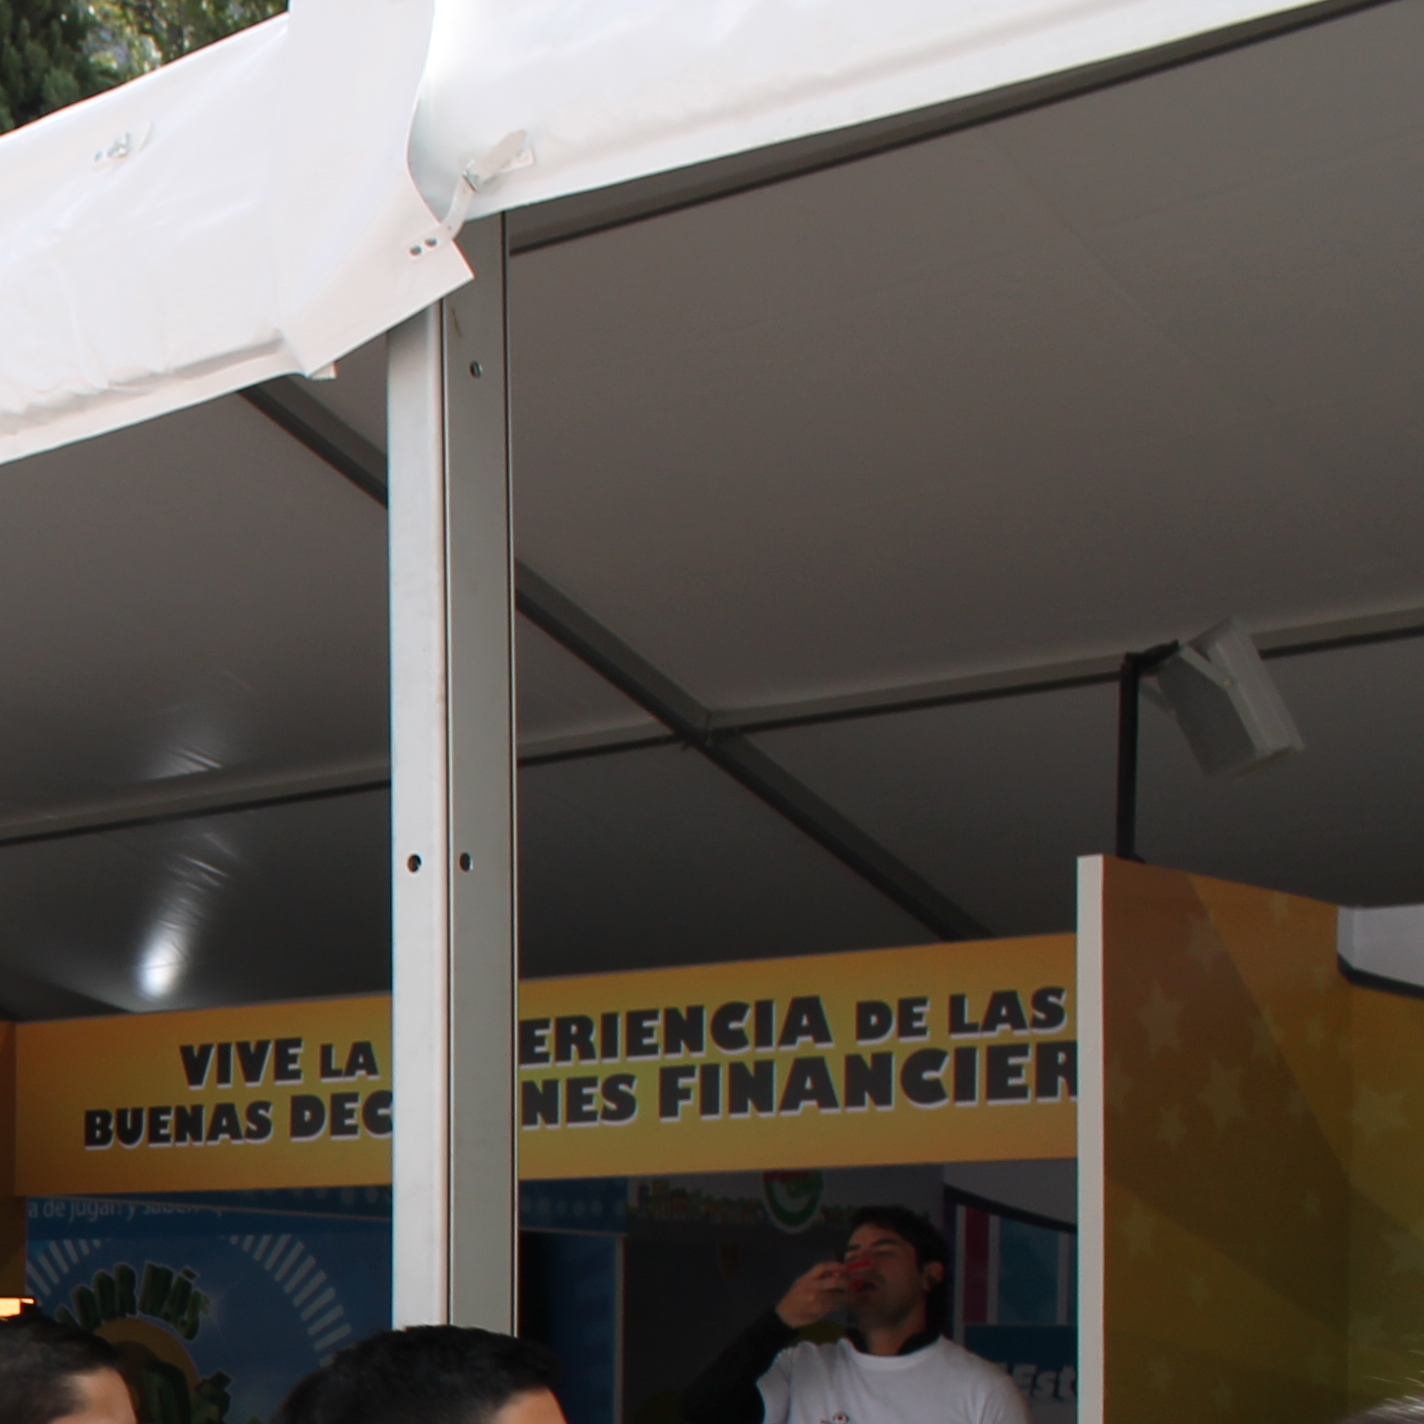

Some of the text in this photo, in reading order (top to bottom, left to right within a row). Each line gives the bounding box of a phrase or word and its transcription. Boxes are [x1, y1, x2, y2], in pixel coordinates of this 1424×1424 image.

[180, 1036, 304, 1090] VIVE
[319, 1040, 381, 1082] LA
[856, 996, 931, 1044] DE
[948, 984, 1070, 1038] LAS
[84, 1100, 274, 1151] BUENAS
[42, 1199, 65, 1218] de
